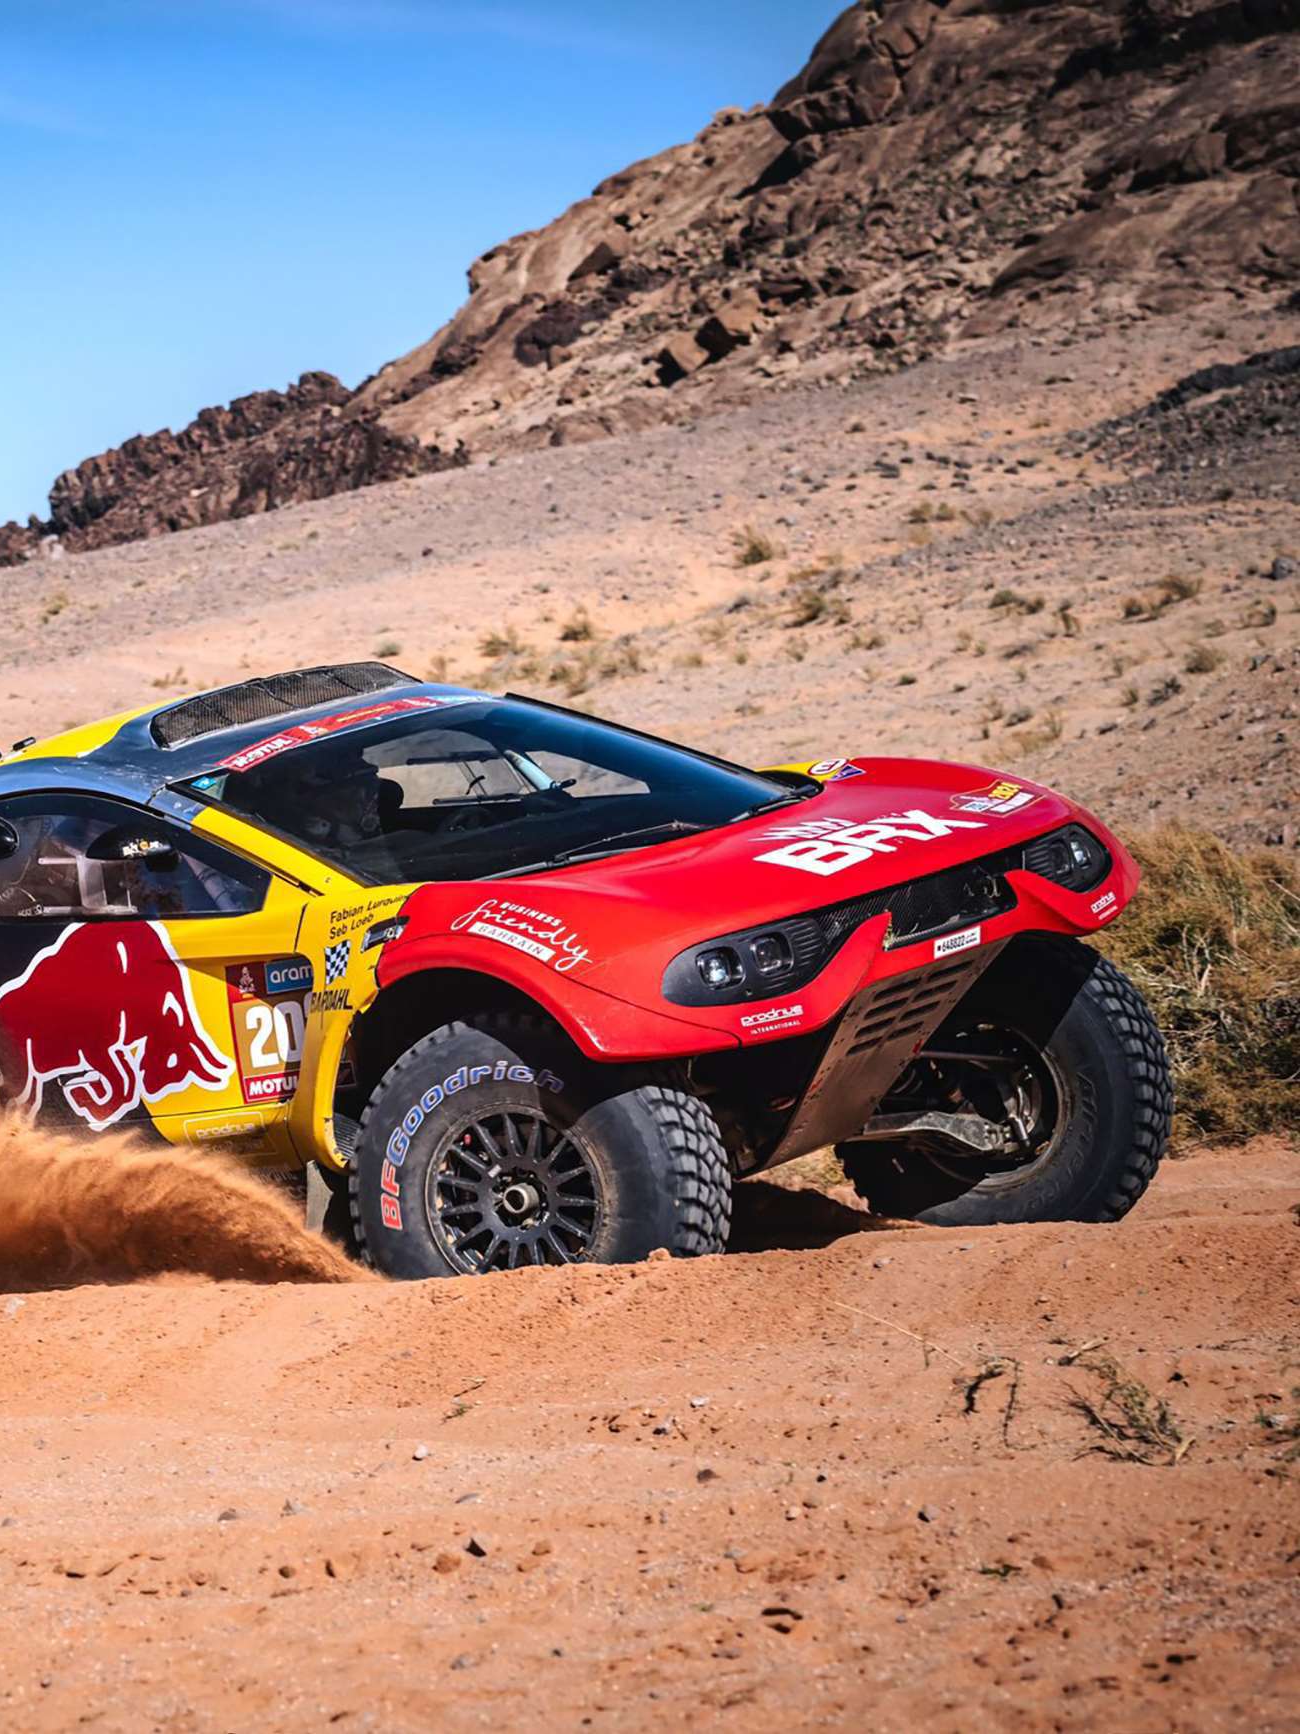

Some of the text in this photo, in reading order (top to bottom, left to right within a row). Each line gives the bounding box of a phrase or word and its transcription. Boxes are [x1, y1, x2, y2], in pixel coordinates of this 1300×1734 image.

[752, 809, 989, 877] BRX
[329, 913, 375, 940] Seb Loeb
[330, 905, 364, 924] Fabian
[499, 901, 562, 927] BUSINESS
[450, 899, 593, 972] friendly
[477, 924, 545, 956] BAHRAIN
[245, 996, 308, 1069] 20
